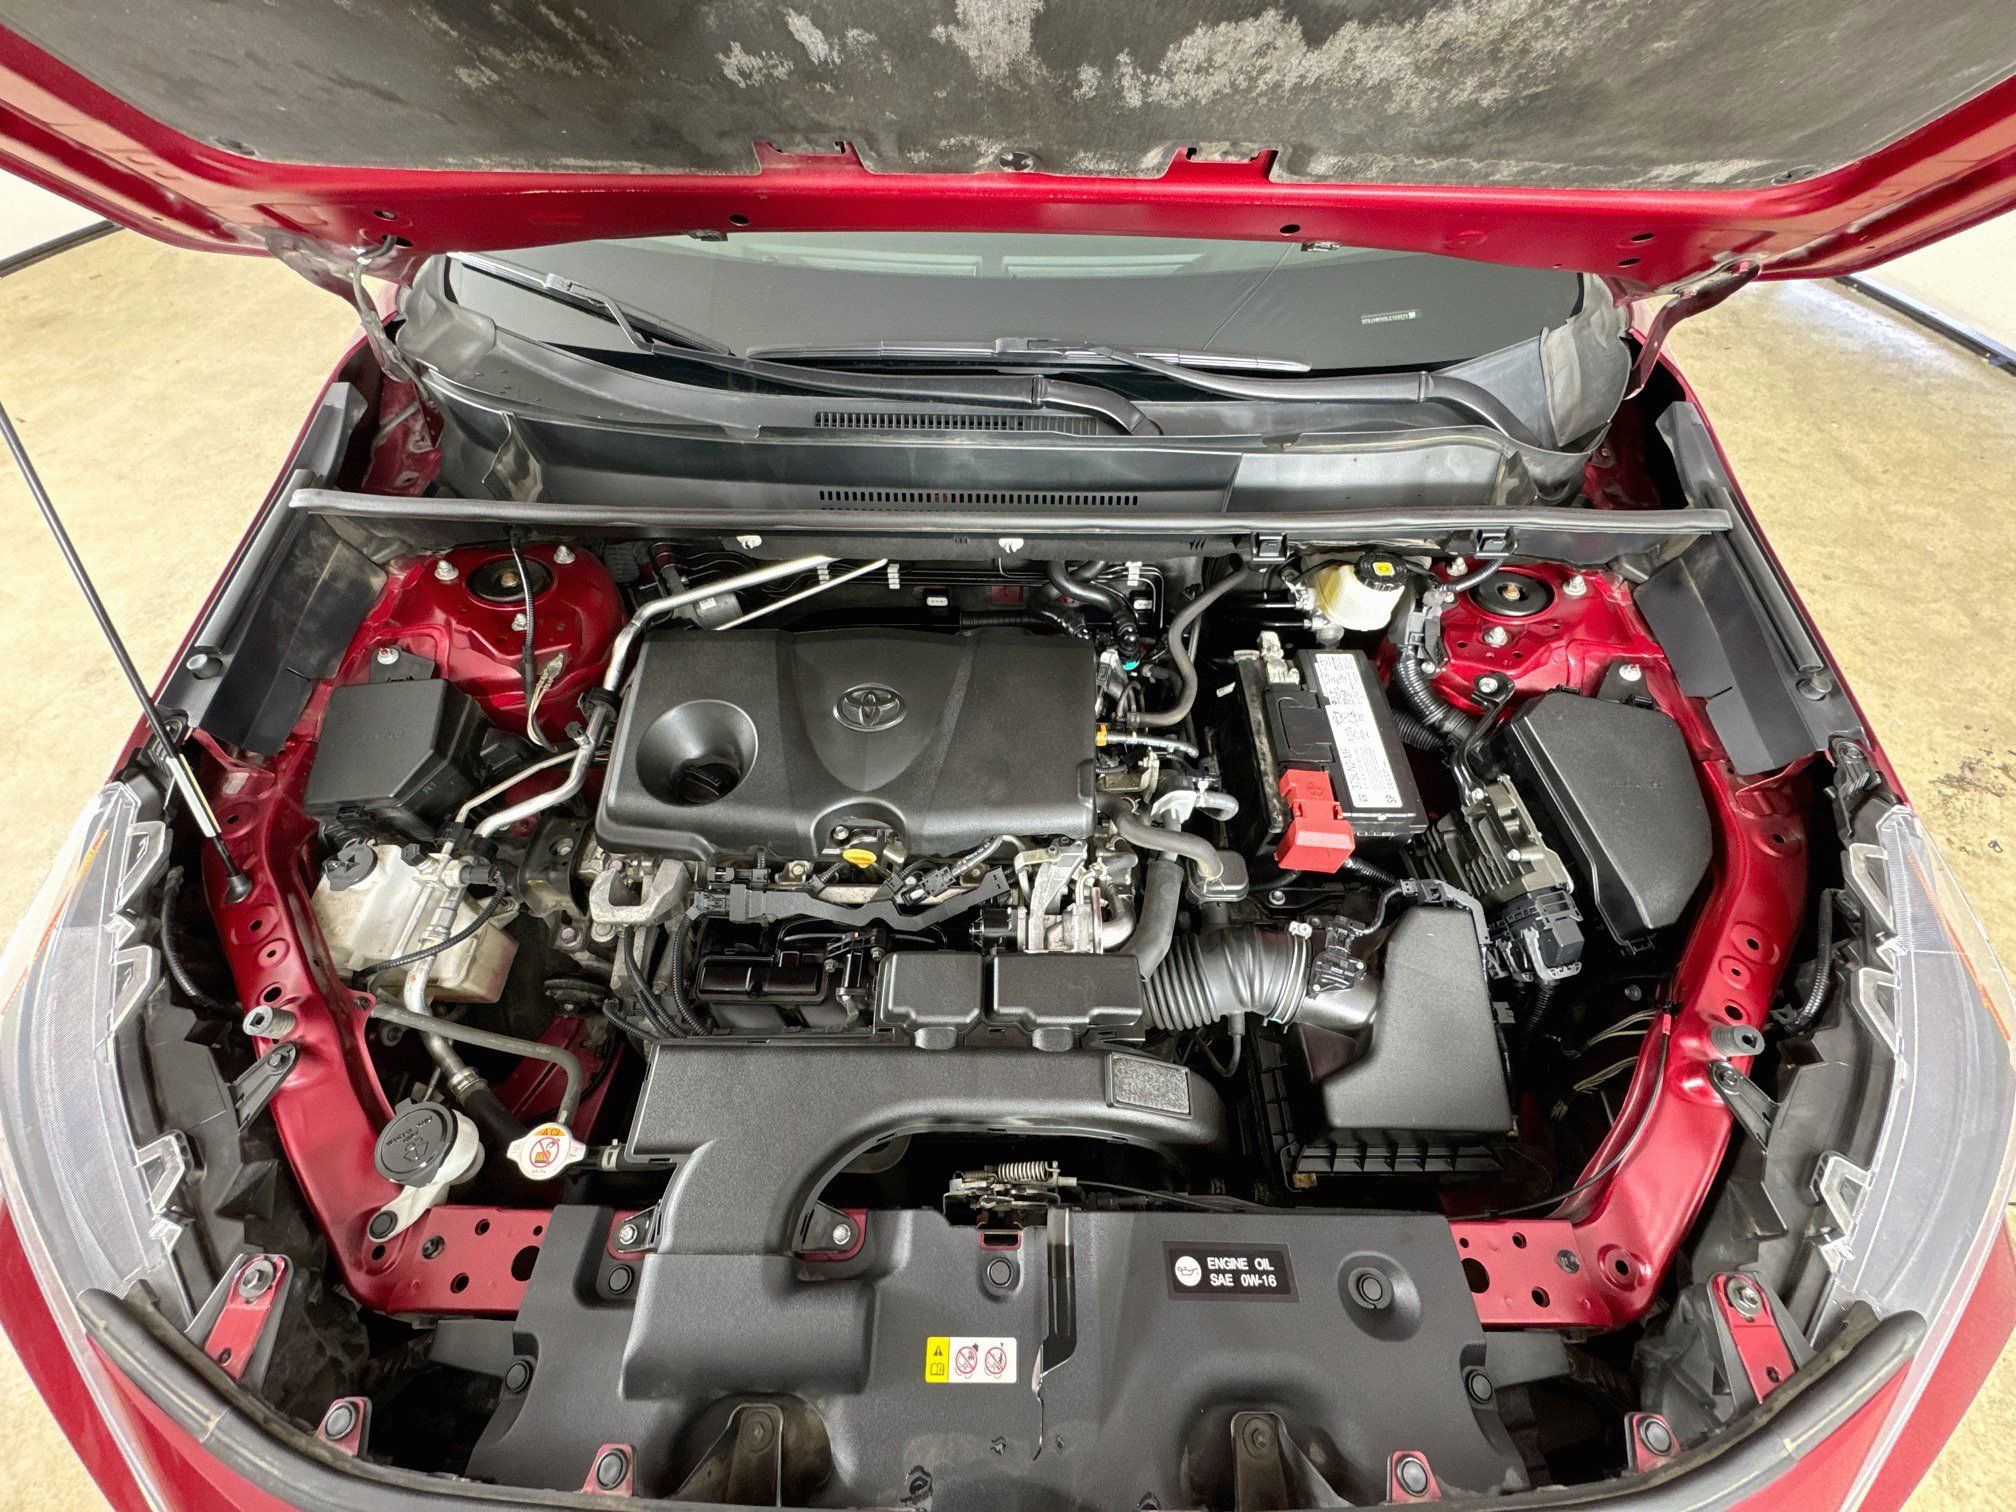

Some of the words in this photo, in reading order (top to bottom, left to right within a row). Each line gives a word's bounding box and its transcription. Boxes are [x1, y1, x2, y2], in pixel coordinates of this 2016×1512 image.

[1207, 1257, 1249, 1270] ENGINE
[1254, 1257, 1274, 1271] OIL
[1210, 1273, 1234, 1287] SAE
[1240, 1274, 1277, 1287] 0W-16
